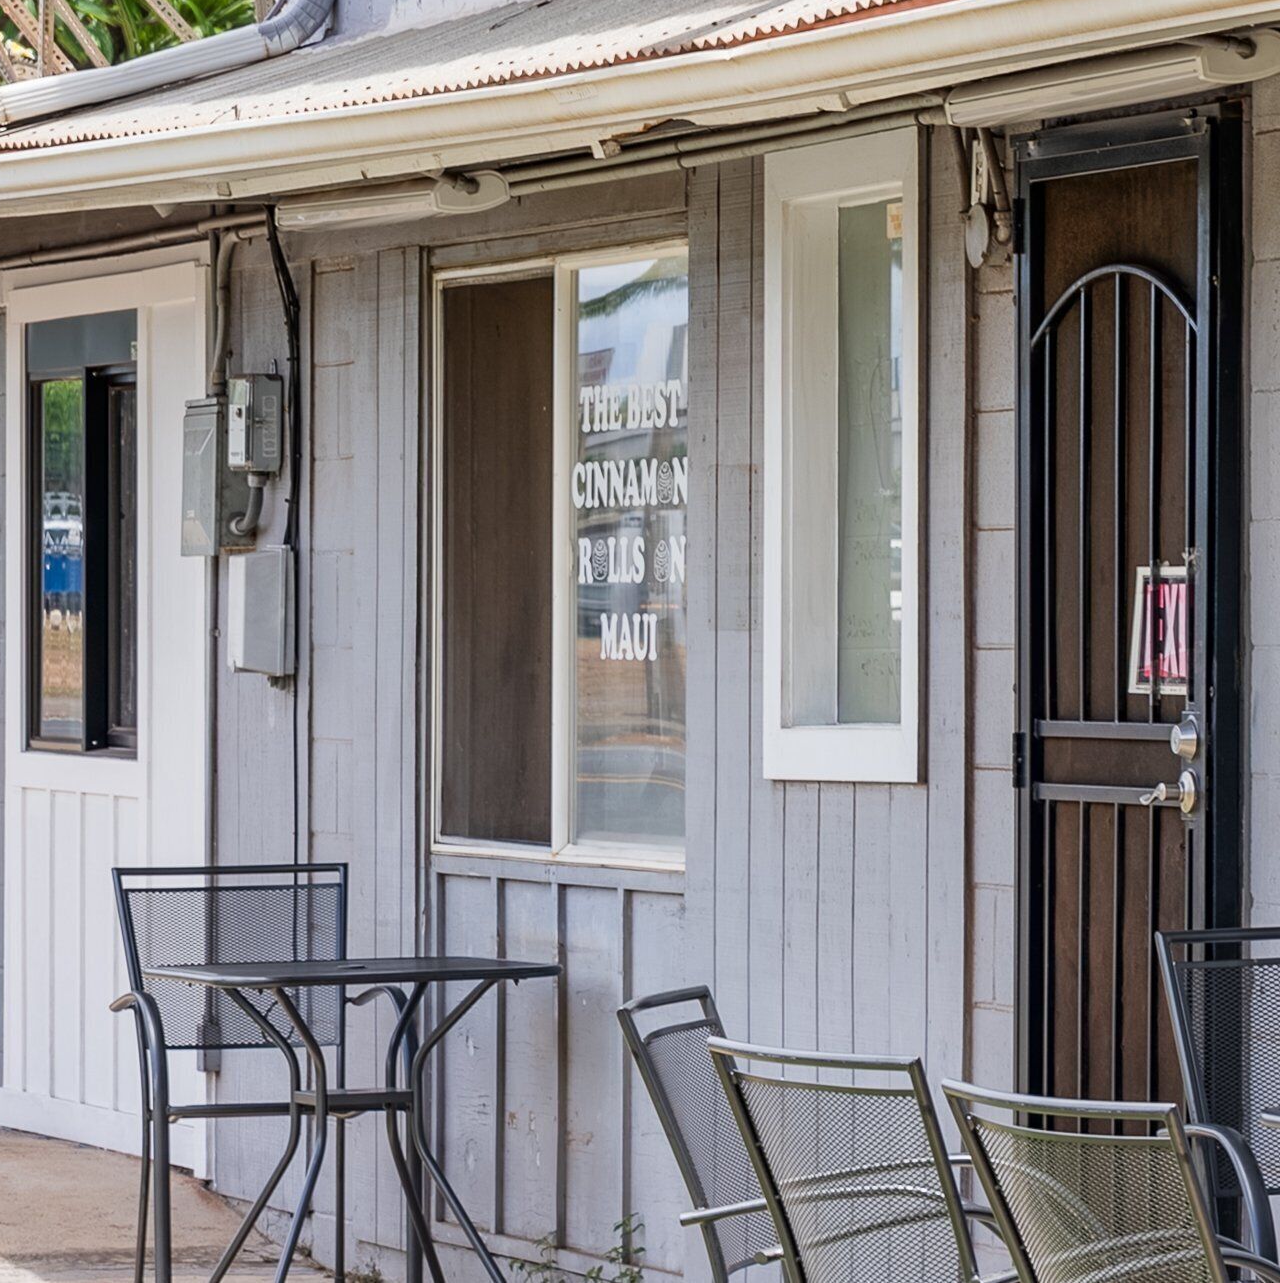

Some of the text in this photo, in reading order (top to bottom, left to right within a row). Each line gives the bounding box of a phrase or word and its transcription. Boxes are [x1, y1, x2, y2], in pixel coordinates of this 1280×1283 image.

[580, 379, 681, 433] THE BEST
[600, 612, 658, 661] MAUI
[1144, 582, 1188, 677] EXI
